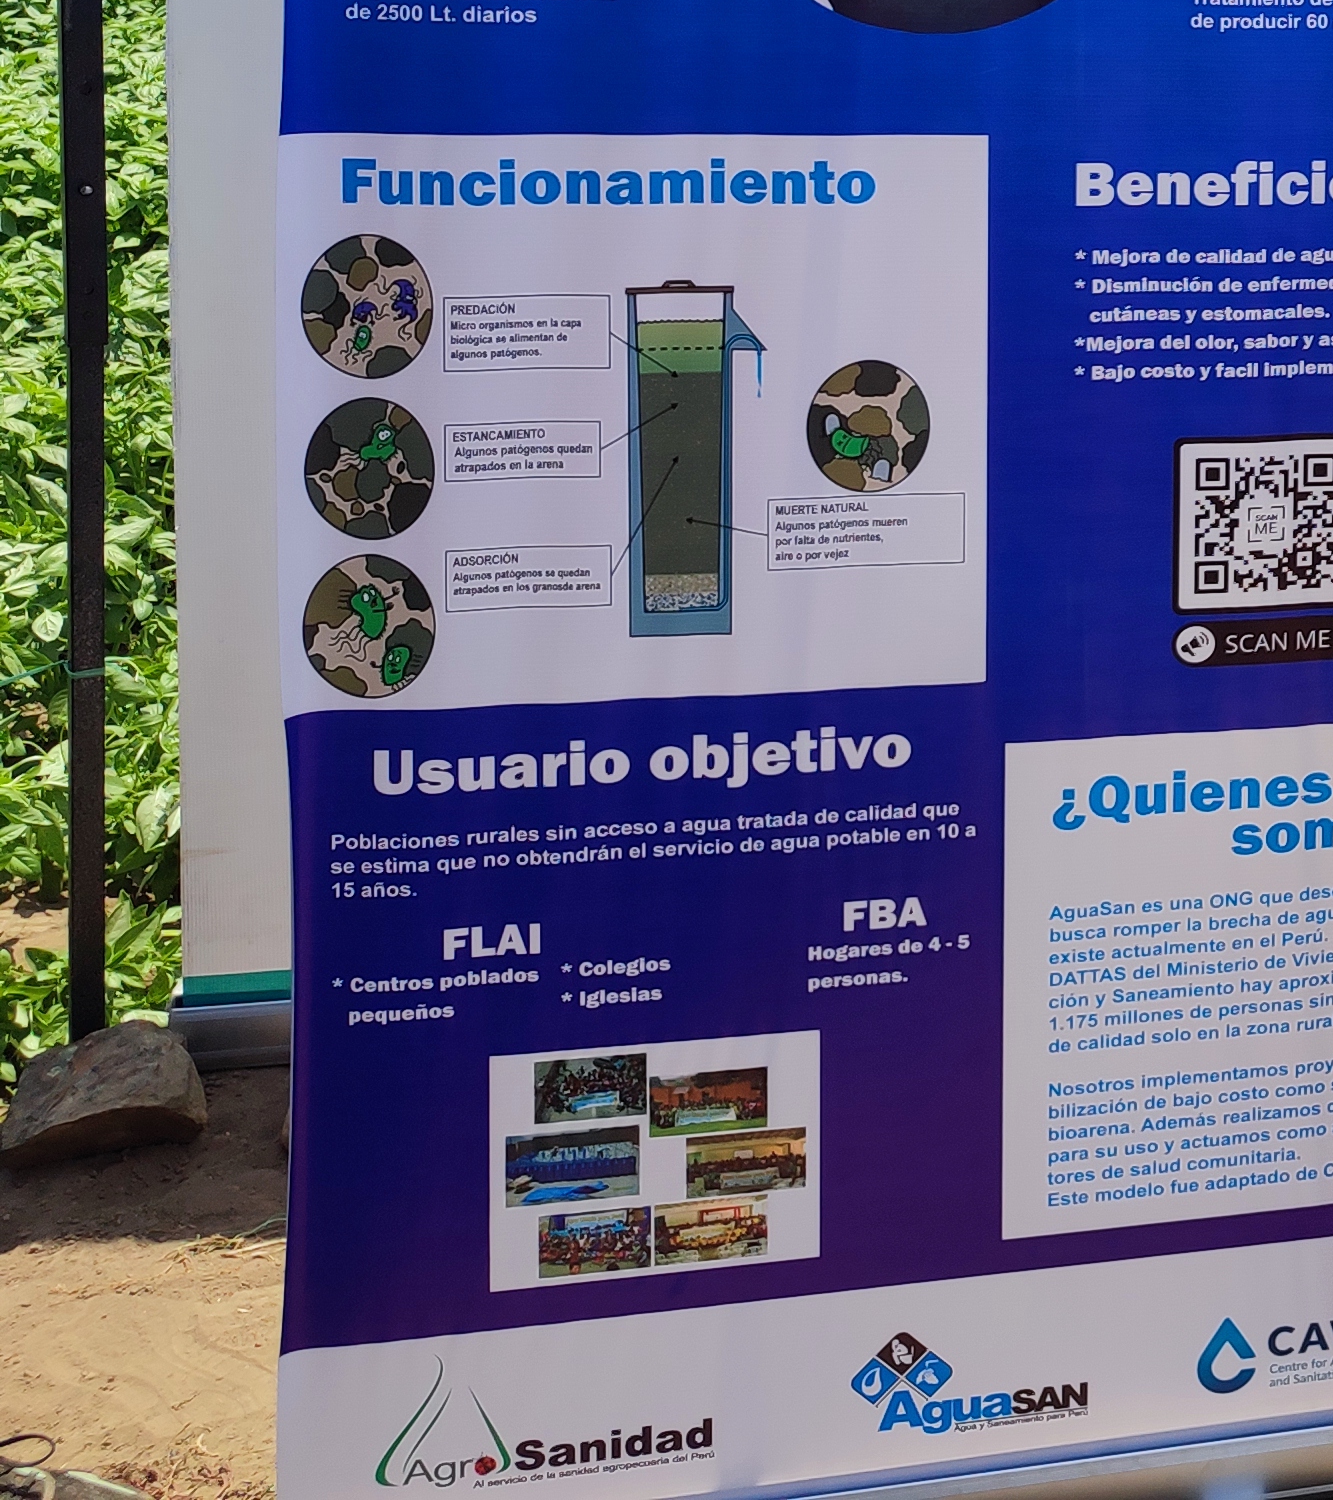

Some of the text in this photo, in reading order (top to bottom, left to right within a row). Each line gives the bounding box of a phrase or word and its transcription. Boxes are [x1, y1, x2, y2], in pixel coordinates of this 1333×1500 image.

[342, 158, 875, 206] Funcionamiento
[451, 302, 515, 315] PREDACIÓN
[453, 428, 545, 442] ESTANCAMIENTO
[776, 502, 869, 515] MUERTE NATURAL
[453, 552, 518, 567] ADSORCIÓN
[1226, 630, 1331, 653] SCAN ME
[374, 727, 911, 795] Usuario objetivo
[1053, 771, 1332, 830] ¿Quienes
[844, 897, 927, 931] FBA
[1049, 901, 1135, 922] AguaSan
[1142, 901, 1163, 913] es
[1170, 899, 1203, 910] una
[1210, 891, 1253, 908] ONG
[1260, 892, 1293, 907] que
[444, 923, 540, 960] FLAI
